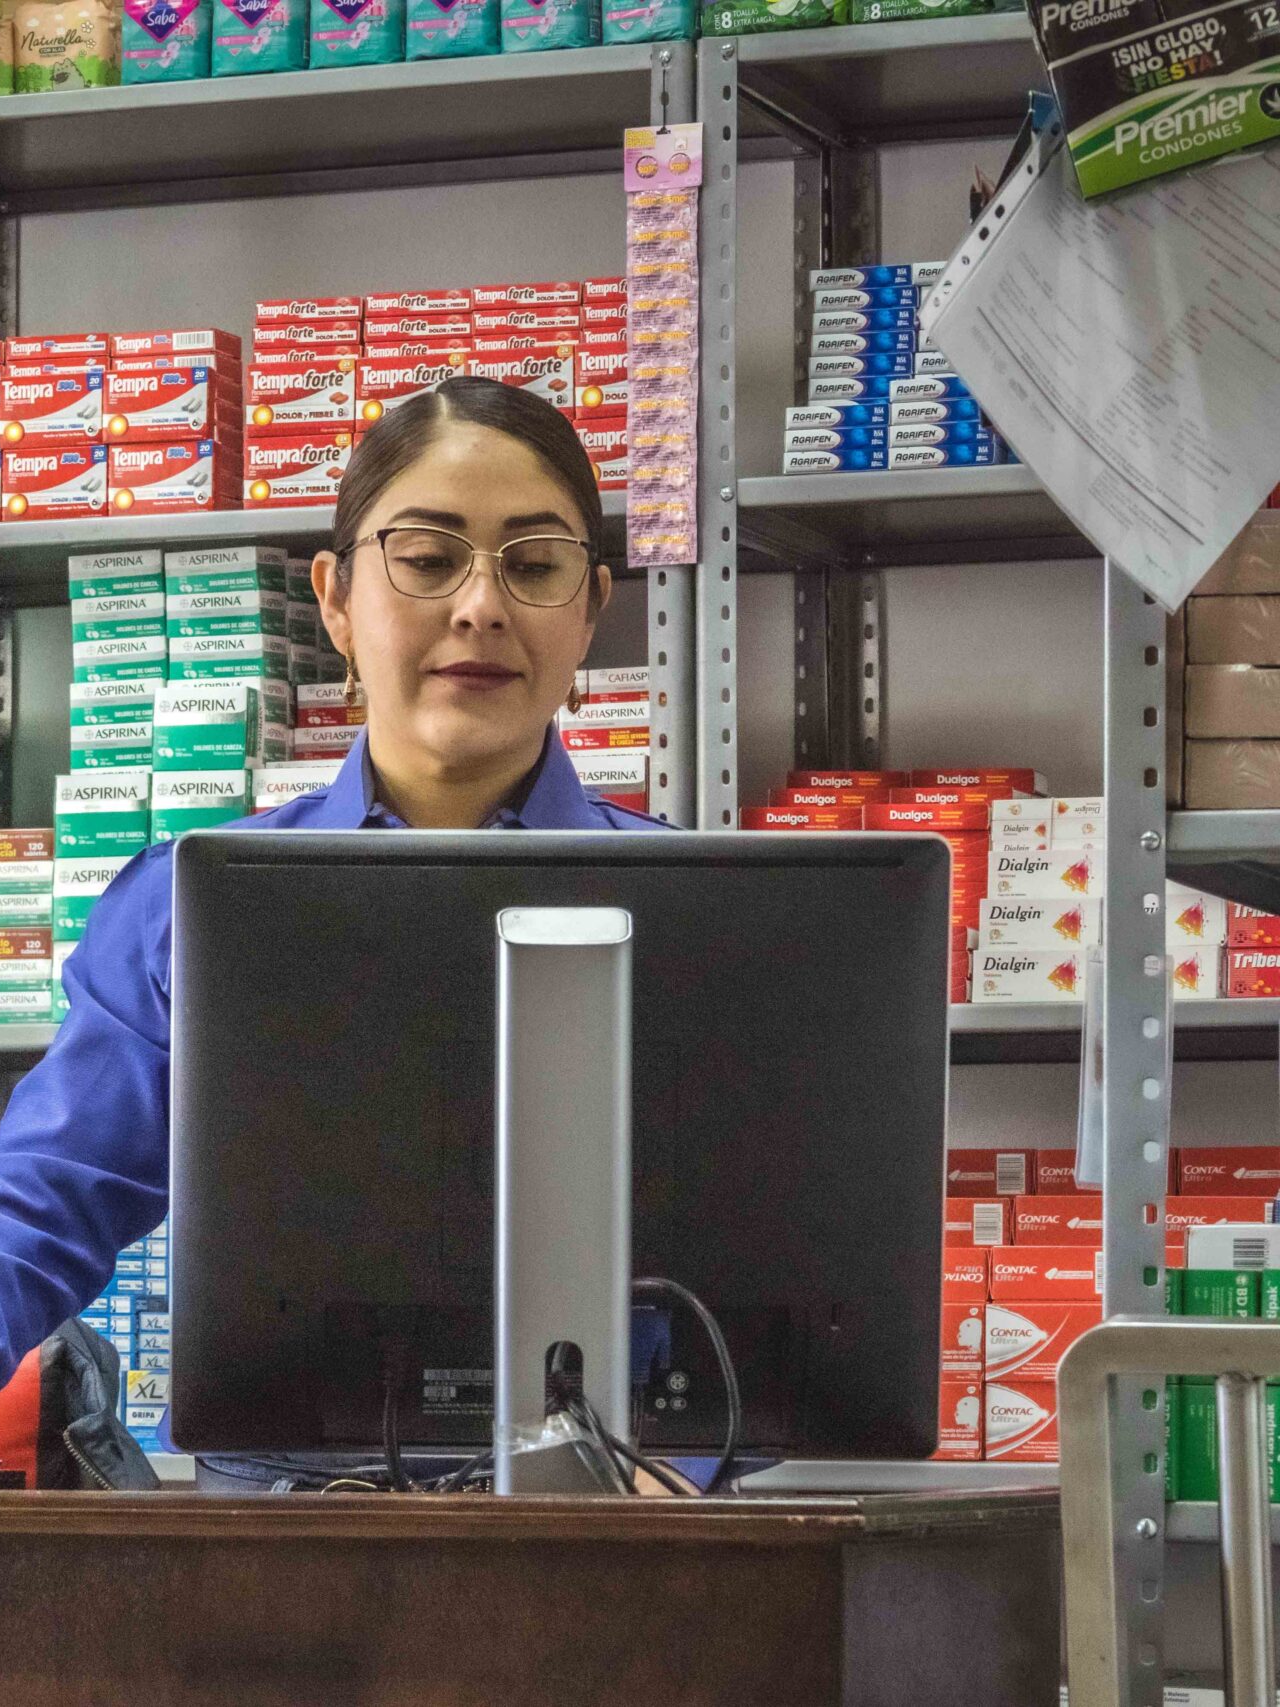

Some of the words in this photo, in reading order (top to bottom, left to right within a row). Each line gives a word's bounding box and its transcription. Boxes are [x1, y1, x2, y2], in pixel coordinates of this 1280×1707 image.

[870, 3, 881, 19] 8
[882, 8, 902, 18] EXTRA
[903, 6, 927, 16] LARGAS
[1042, 0, 1136, 30] Prem
[1251, 7, 1279, 29] 12
[147, 12, 178, 27] Saba
[721, 12, 732, 29] 8
[733, 9, 759, 18] TOALLAS
[733, 17, 753, 27] EXTRA
[753, 15, 776, 25] LARGAS
[1070, 7, 1130, 31] CONDONES
[21, 29, 84, 48] Naturella
[1154, 17, 1227, 48] GLOBO,
[1130, 56, 1163, 77] NO
[1170, 38, 1215, 63] HAY
[1133, 50, 1223, 92] FIESTA!
[1114, 88, 1253, 155] Premier
[1139, 120, 1243, 164] CONDONES
[816, 274, 856, 284] AGRIFEN
[366, 296, 399, 311] Tempra
[400, 294, 427, 308] forte
[473, 289, 506, 304] Tempra
[507, 287, 535, 300] forte
[821, 295, 861, 304] AGRIFEN
[256, 303, 288, 319] Tempra
[289, 303, 316, 315] forte
[819, 317, 859, 326] AGRIFEN
[10, 340, 41, 356] Tempra
[107, 373, 158, 397] Tempra
[250, 371, 305, 394] Tempra
[304, 370, 346, 390] forte
[360, 366, 415, 390] Tempra
[414, 365, 455, 384] forte
[1, 380, 53, 403] Tempra
[815, 384, 855, 392] AGRIFEN
[896, 384, 937, 394] AGRIFEN
[275, 411, 303, 420] DOLOR
[792, 413, 832, 421] AGRIFEN
[6, 453, 57, 475] Tempra
[111, 446, 163, 470] Tempra
[248, 447, 301, 468] Tempra
[300, 446, 342, 464] forte
[790, 457, 831, 466] AGRIFEN
[895, 452, 936, 461] AGRIFEN
[92, 555, 144, 569] ASPIRINA
[188, 552, 240, 566] ASPIRINA
[172, 699, 236, 713] ASPIRINA
[578, 707, 645, 720] CAFIASPIRINA
[95, 728, 147, 739] ASPIRINA
[811, 776, 853, 788] Dualgos
[937, 774, 980, 786] Dualgos
[74, 785, 138, 800] ASPIRINA
[170, 781, 234, 796] ASPIRINA
[766, 813, 809, 825] Dualgos
[889, 809, 933, 822] Dualgos
[998, 858, 1050, 873] Dialgin
[989, 906, 1042, 922] Dialgin
[983, 957, 1036, 973] Dialgin
[1183, 1165, 1226, 1175] CONTAC
[1017, 1214, 1060, 1224] CONTAC
[995, 1264, 1038, 1275] CONTAC
[1236, 1287, 1248, 1306] BD
[990, 1327, 1032, 1338] CONTAC
[134, 1379, 163, 1399] XL
[132, 1411, 155, 1419] GRIPA
[991, 1406, 1034, 1416] CONTAC
